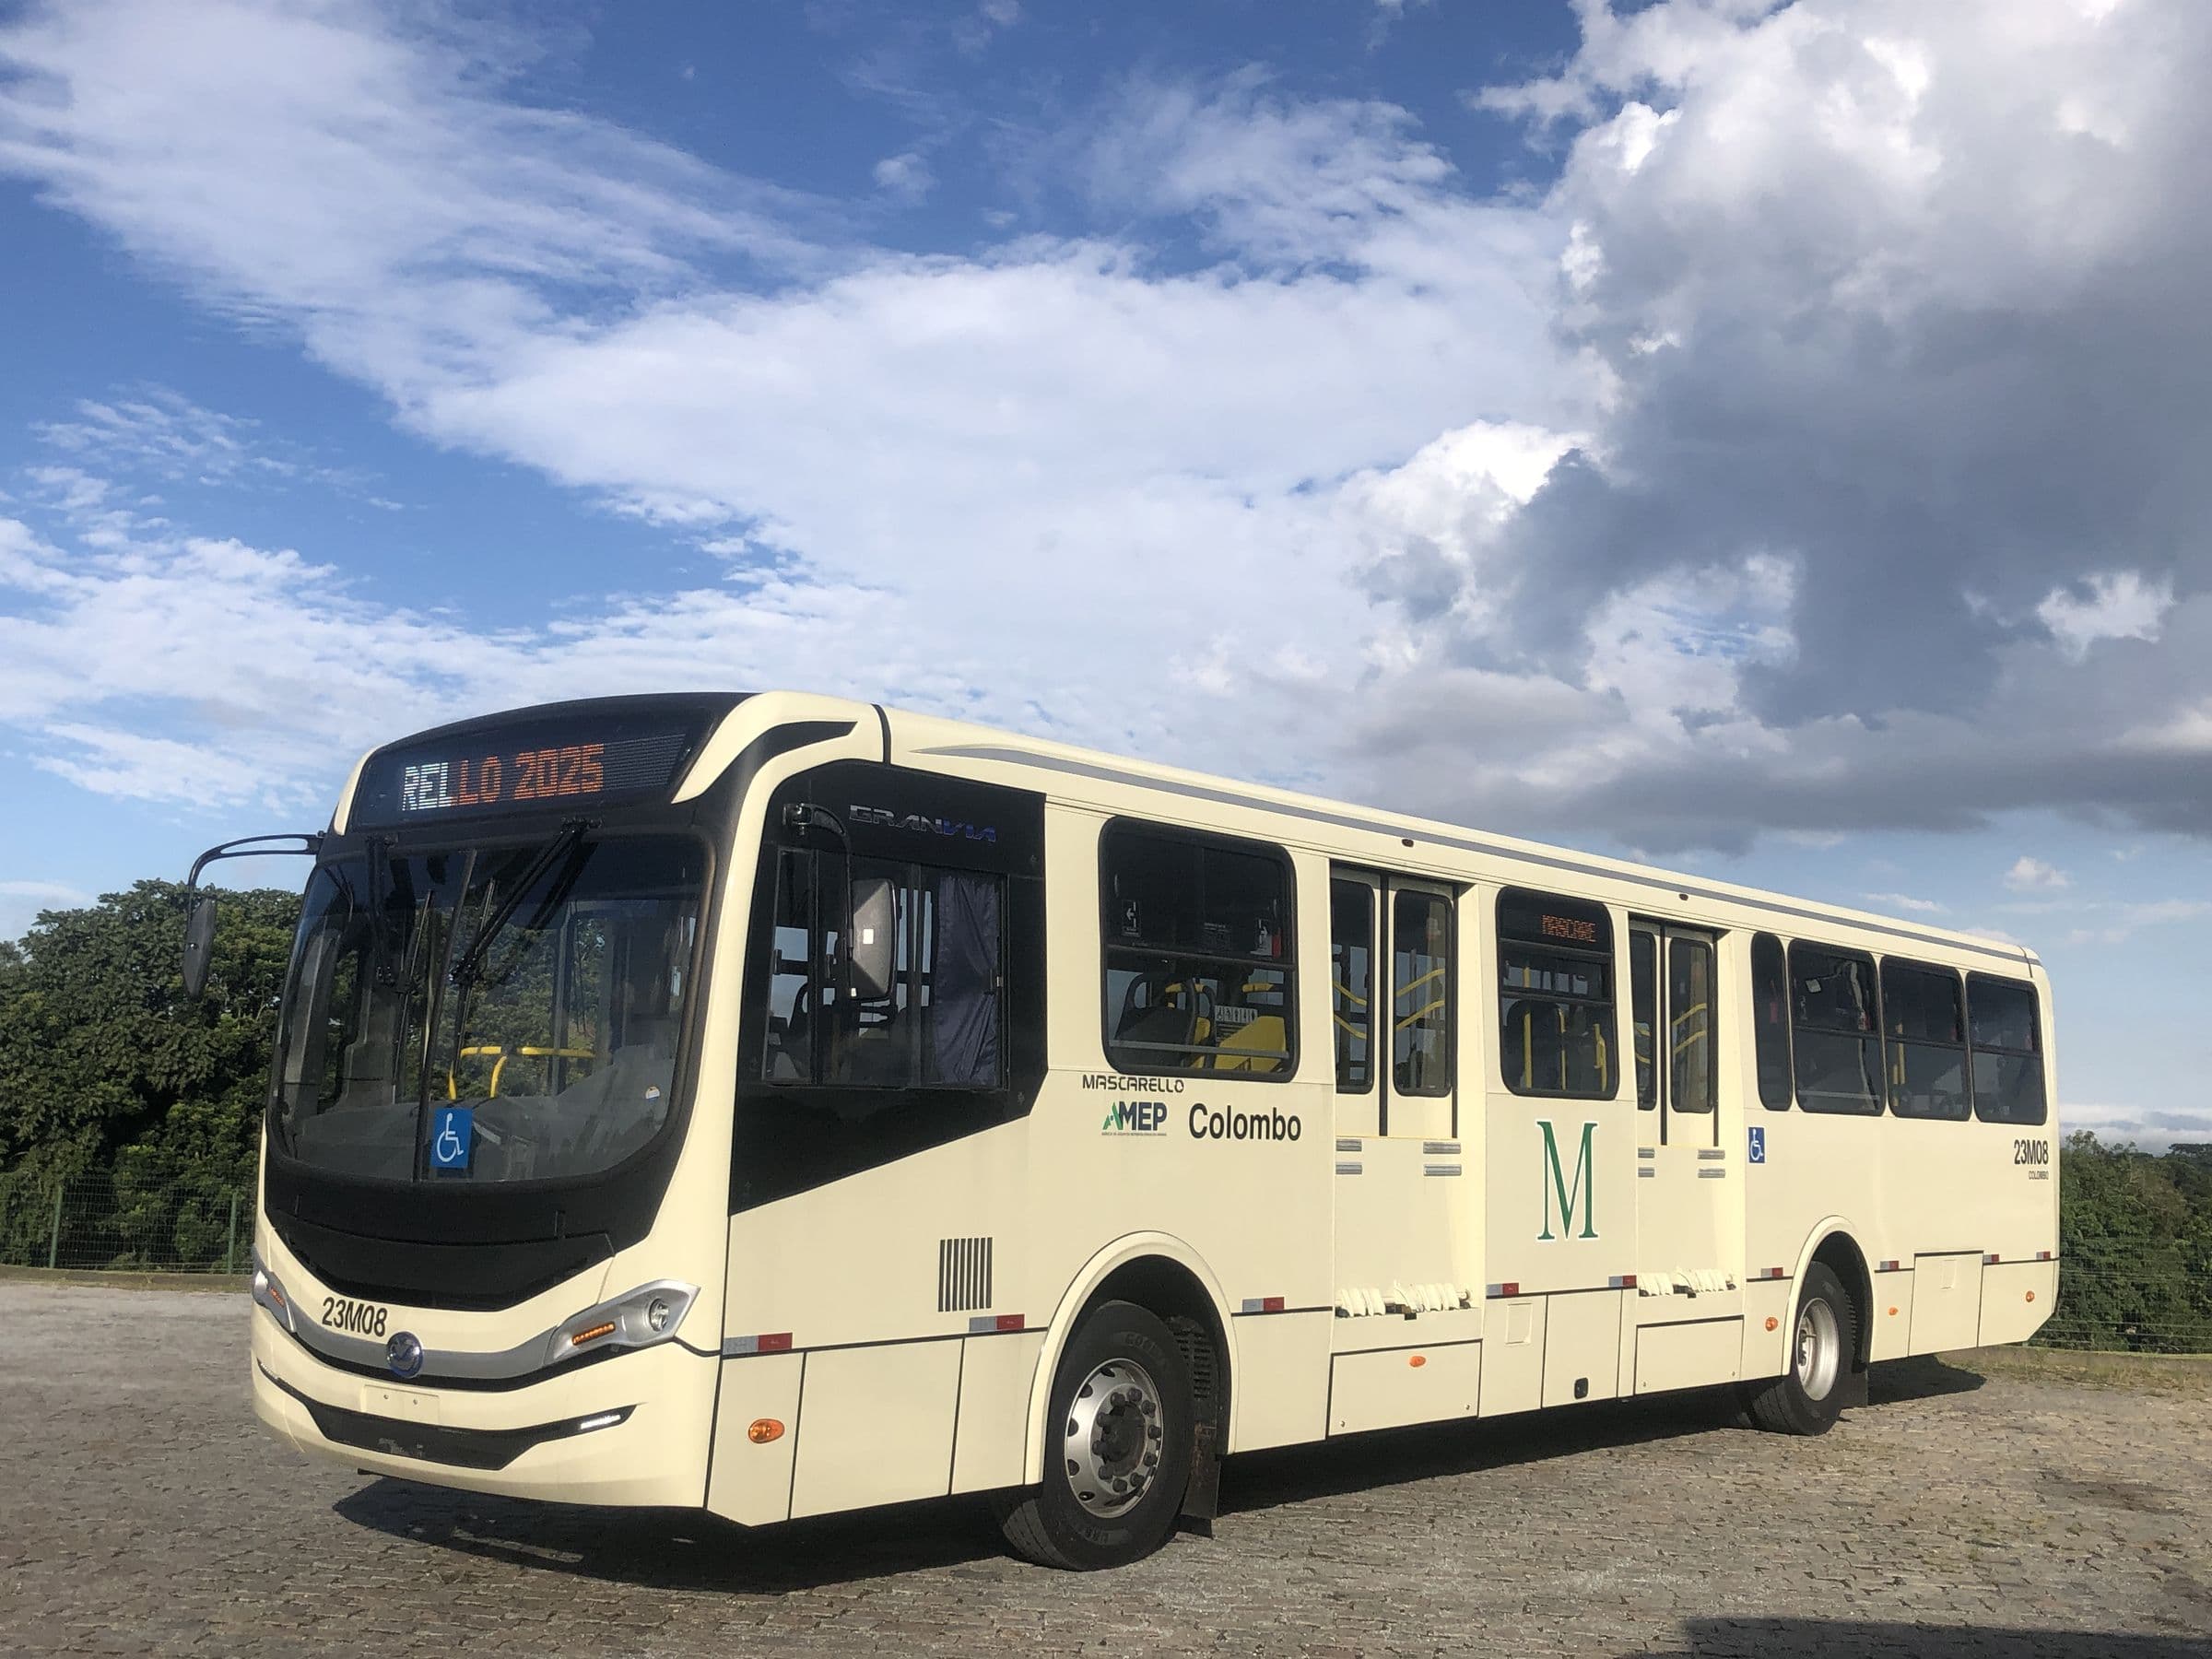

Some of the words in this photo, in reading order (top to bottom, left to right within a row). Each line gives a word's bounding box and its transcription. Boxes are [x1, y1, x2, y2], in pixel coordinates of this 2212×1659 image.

[514, 744, 605, 800] 2025
[1082, 1074, 1184, 1093] MASCARELLO
[1102, 1100, 1168, 1131] AMEP
[1189, 1102, 1301, 1141] Colombo
[2014, 1139, 2049, 1165] 23M08
[1536, 1121, 1599, 1241] M
[322, 1296, 388, 1337] 23M08
